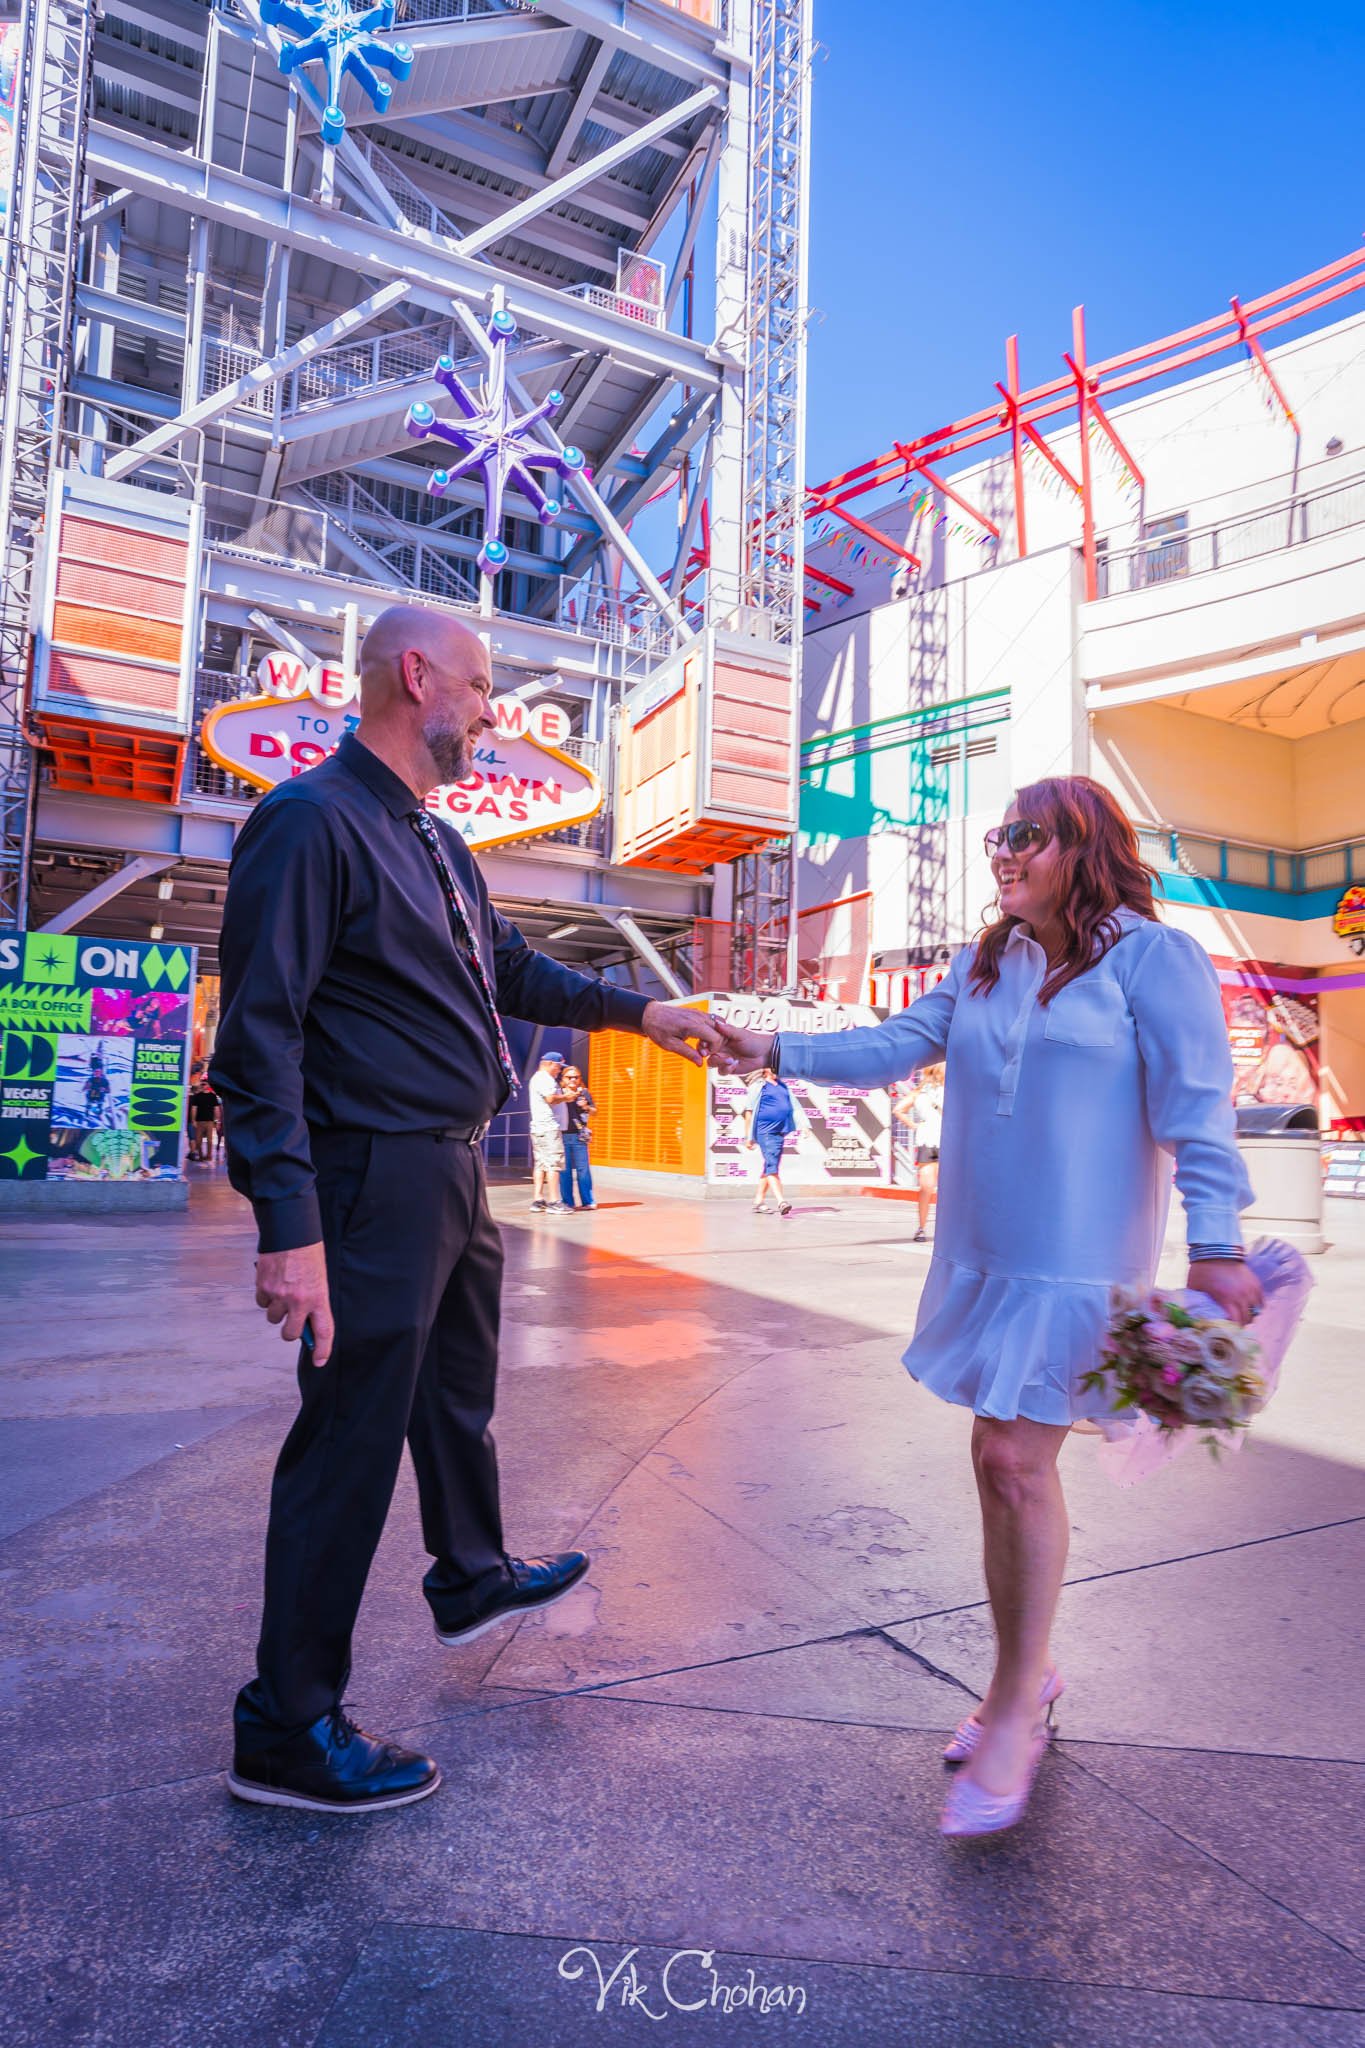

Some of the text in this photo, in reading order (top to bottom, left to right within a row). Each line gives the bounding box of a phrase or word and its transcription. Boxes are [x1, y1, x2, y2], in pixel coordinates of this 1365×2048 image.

[297, 715, 329, 735] TO
[425, 787, 529, 822] EGAS
[80, 946, 140, 979] ON
[41, 1000, 84, 1013] OFFICE
[136, 1050, 180, 1064] STORY
[1, 1106, 50, 1119] ZIPLINE
